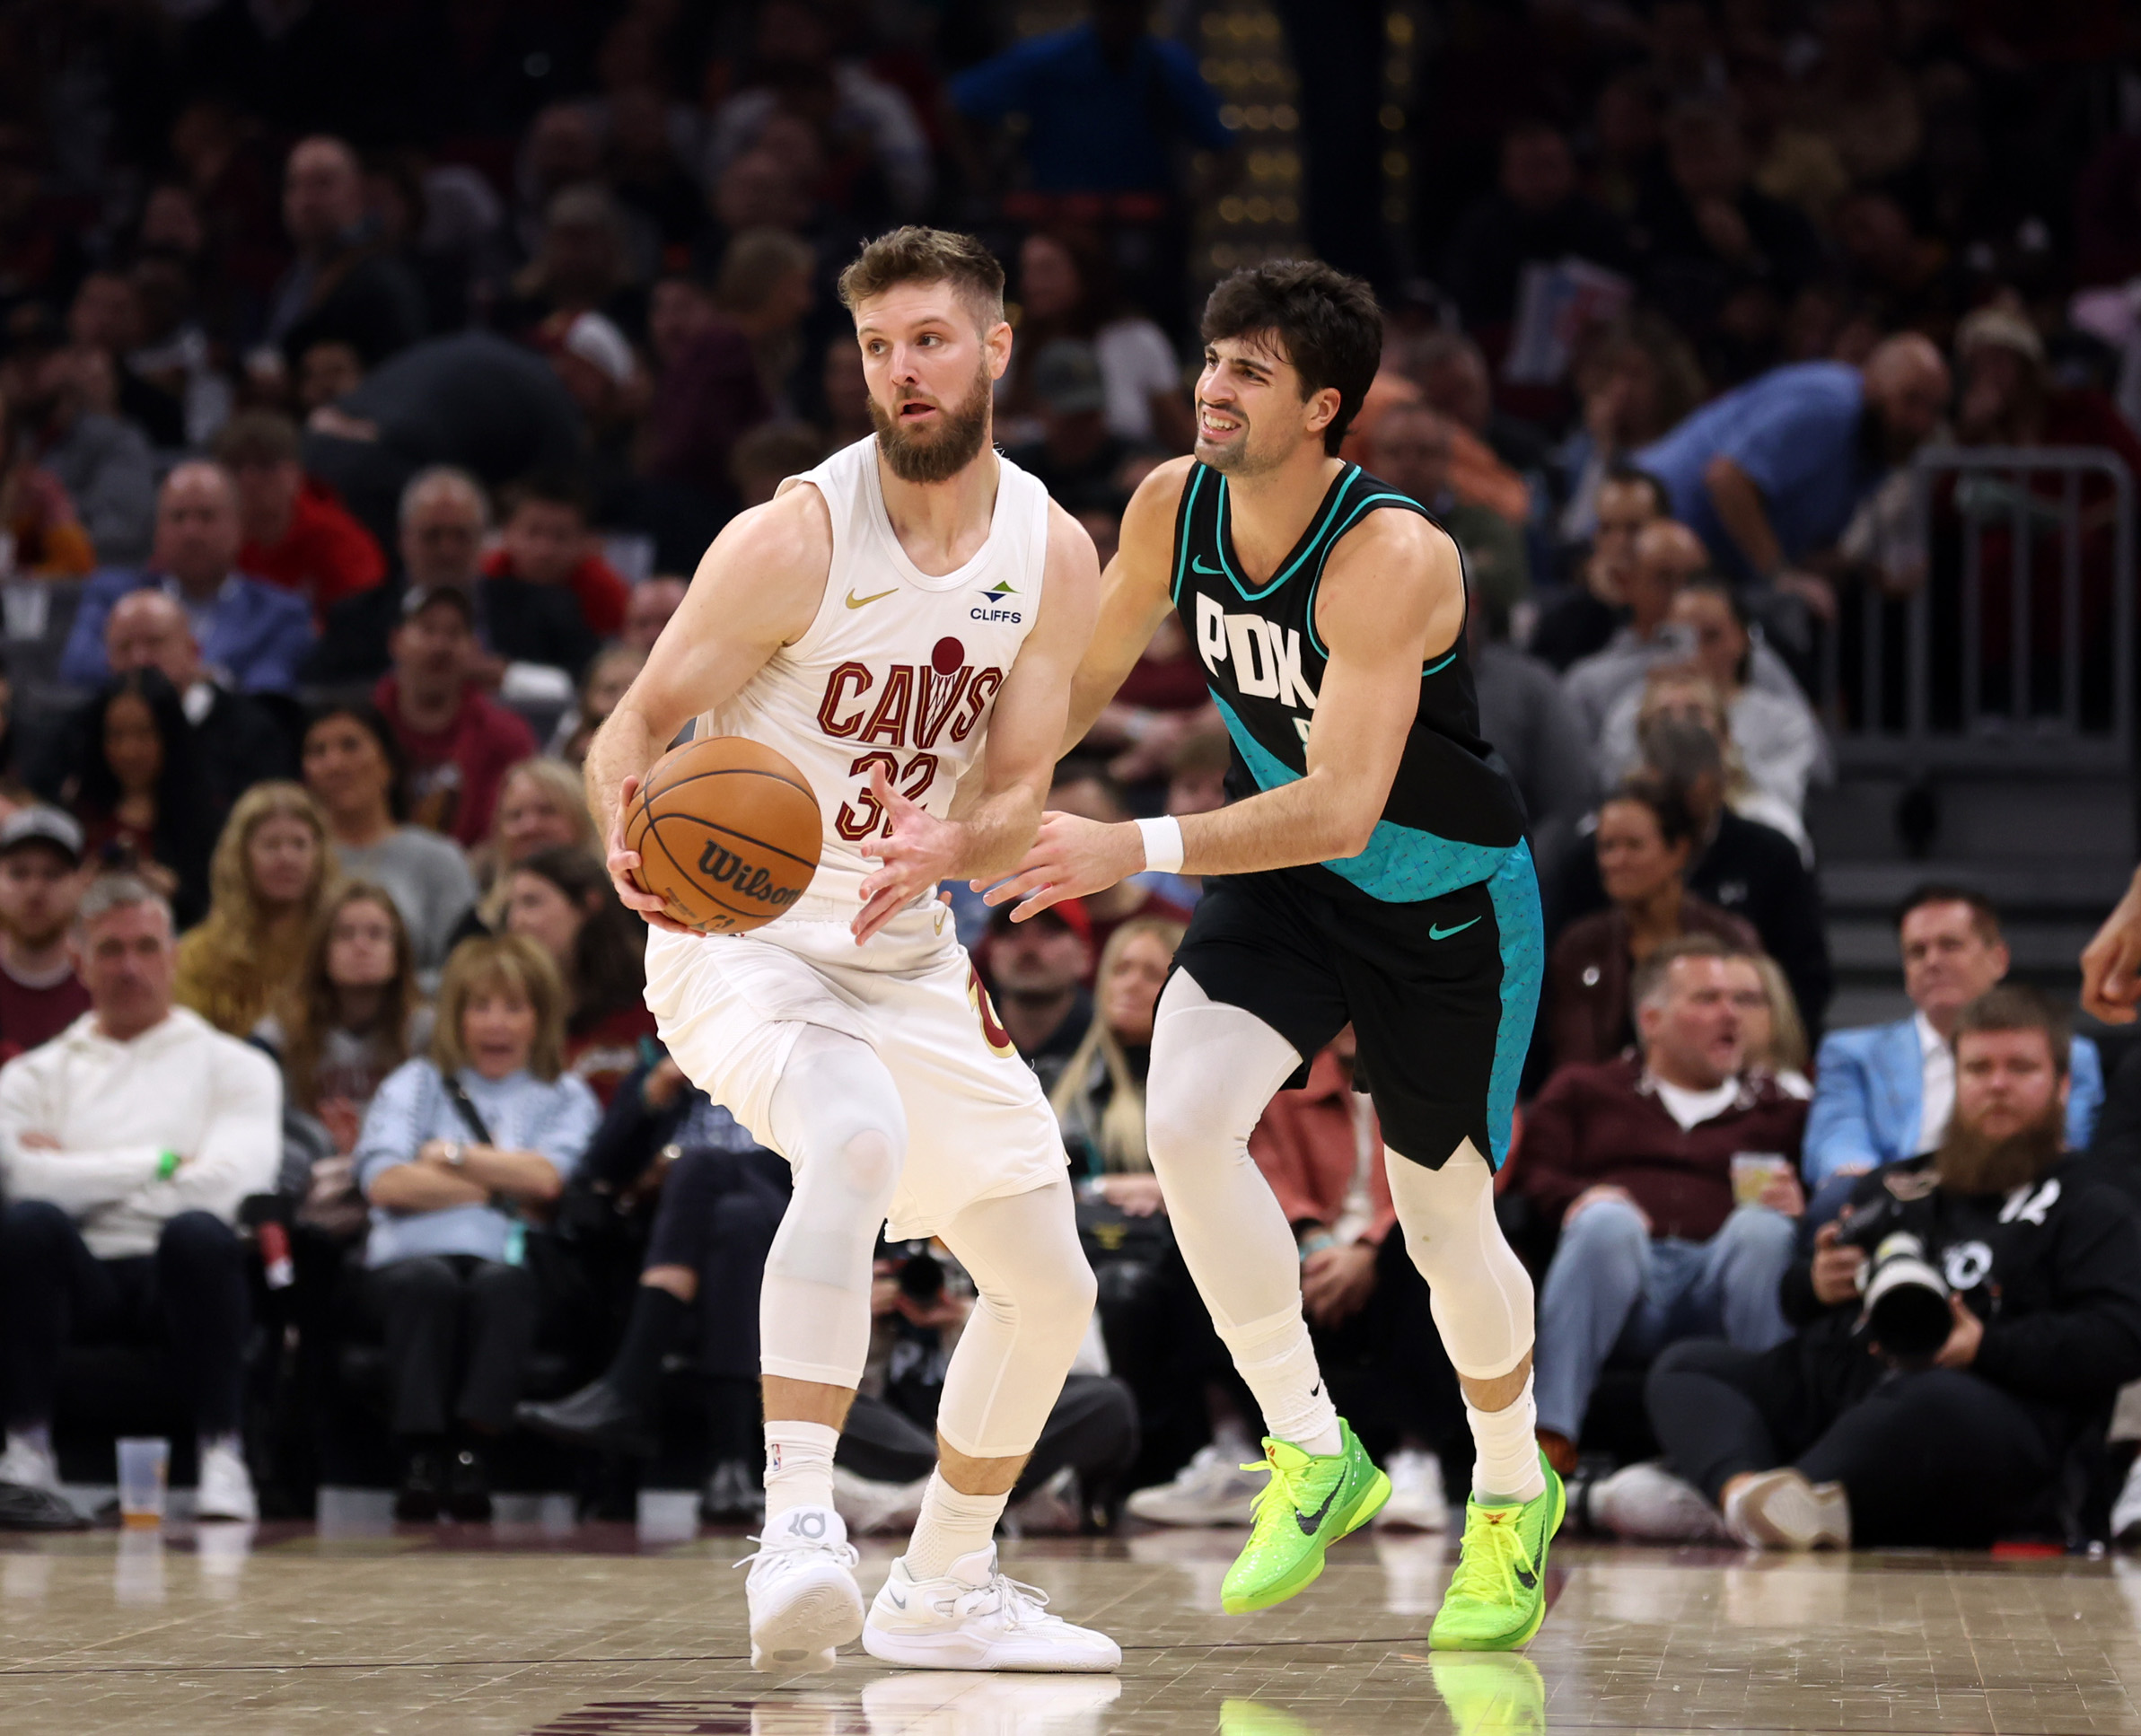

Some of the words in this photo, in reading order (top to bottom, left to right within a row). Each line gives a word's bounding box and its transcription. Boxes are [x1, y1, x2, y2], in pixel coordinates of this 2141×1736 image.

[970, 607, 1022, 625] CLIFFS
[1196, 591, 1318, 709] PDX
[817, 661, 1004, 750] CAVS
[697, 837, 803, 907] Wilson
